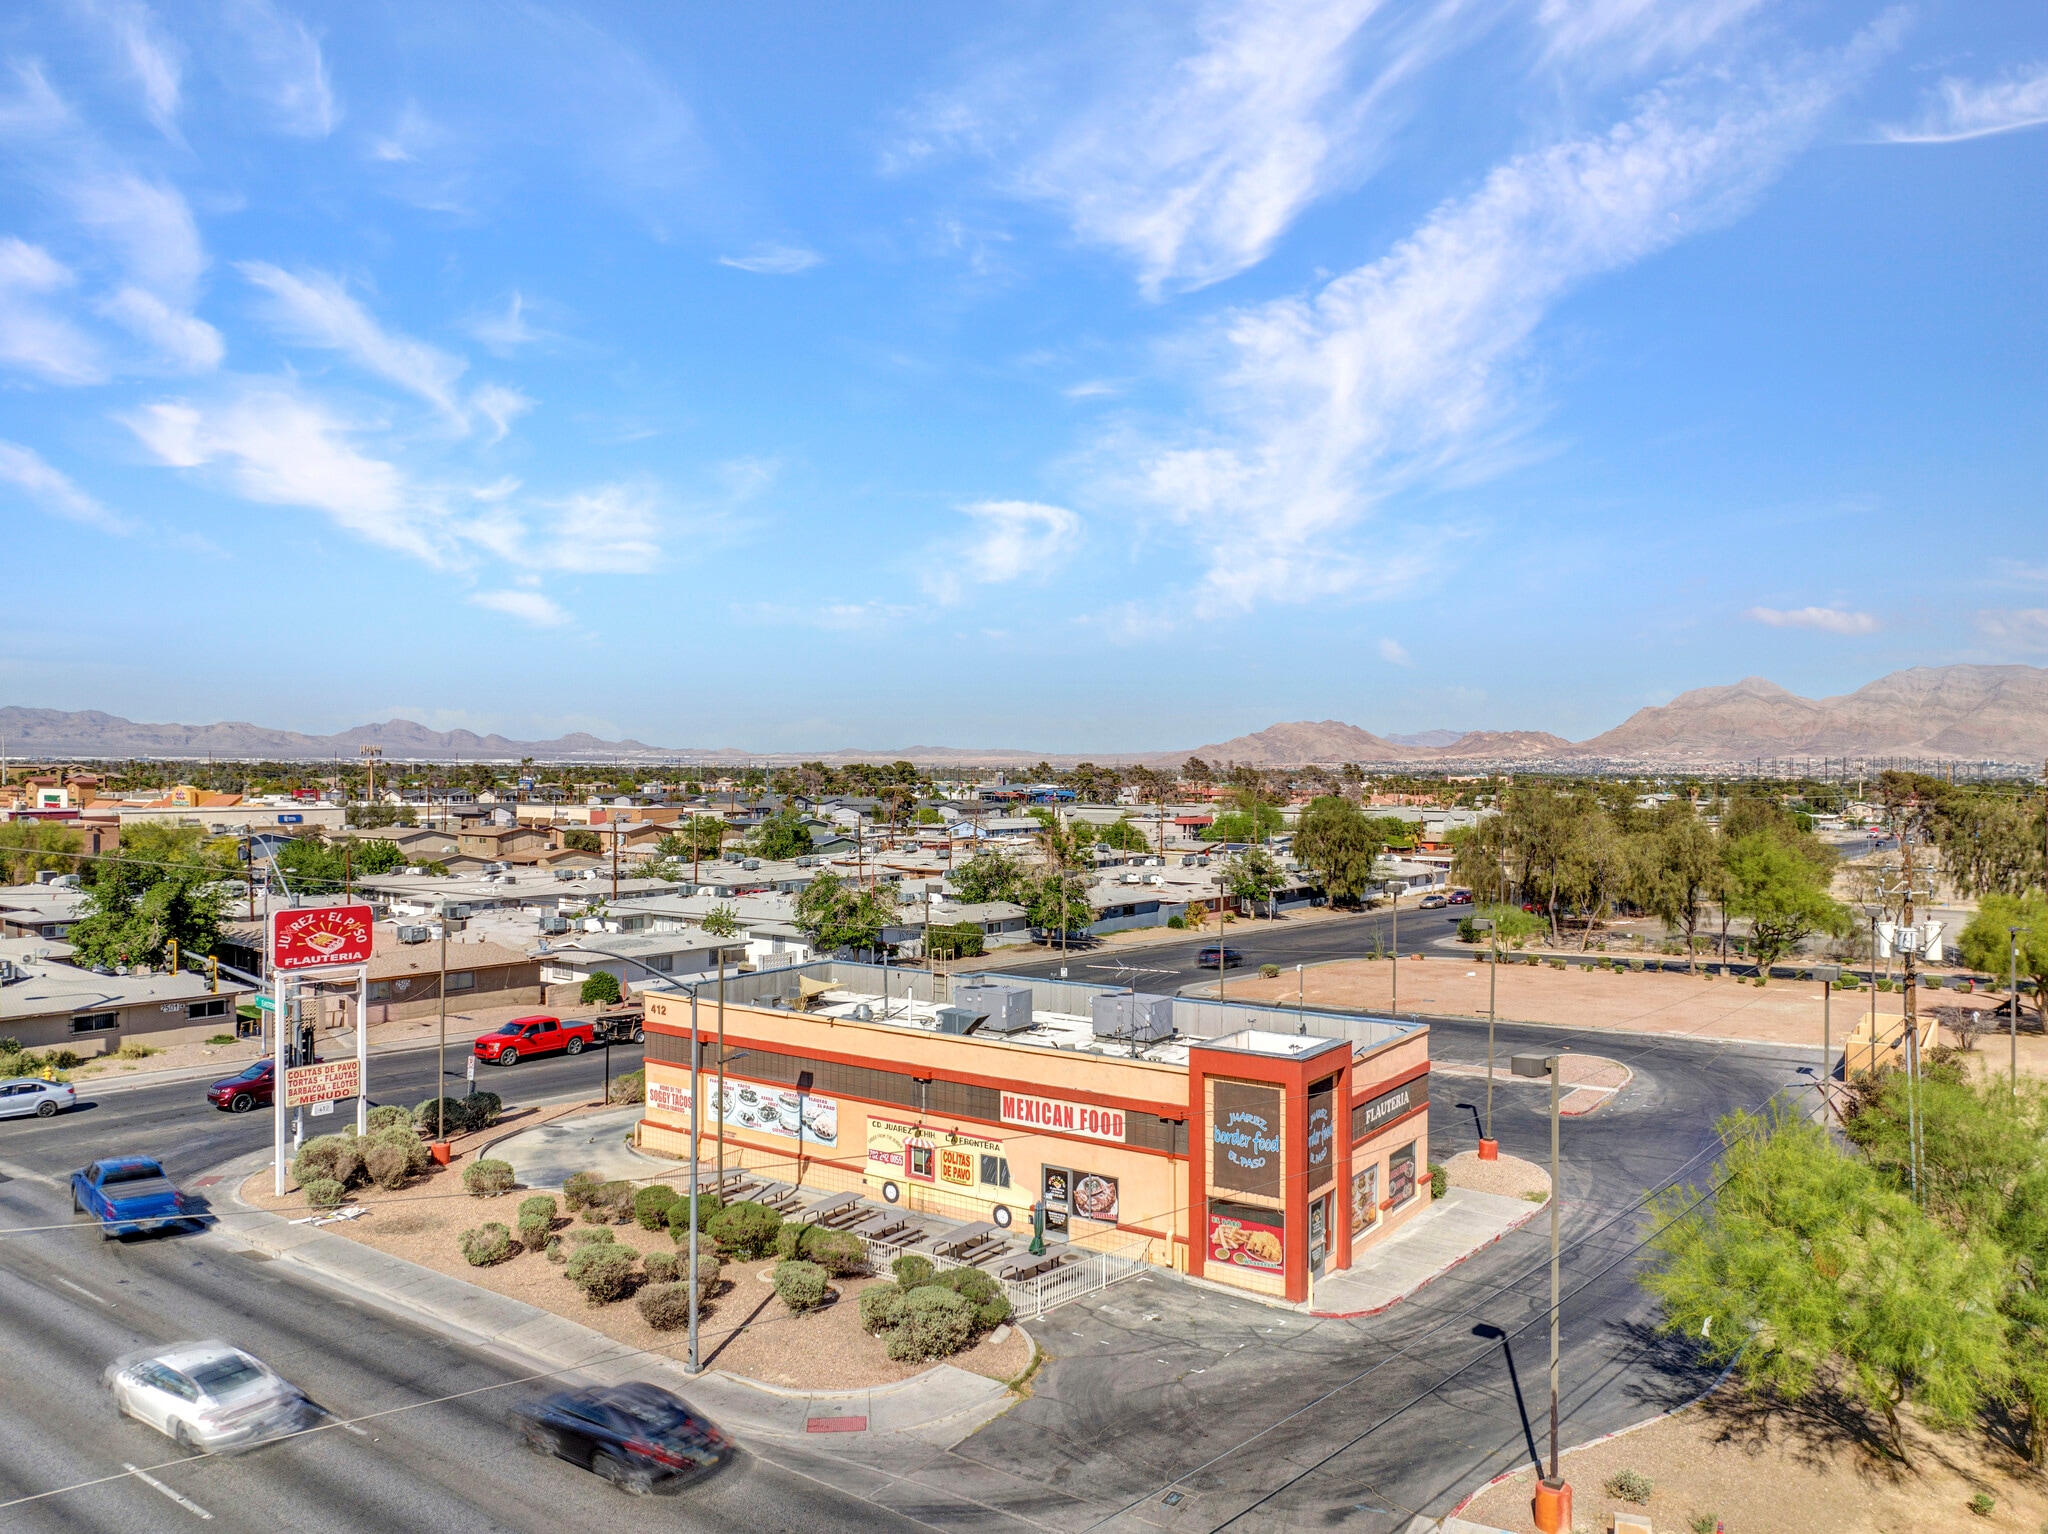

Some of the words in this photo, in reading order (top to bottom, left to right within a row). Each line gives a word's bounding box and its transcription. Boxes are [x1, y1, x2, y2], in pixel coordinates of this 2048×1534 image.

[328, 912, 342, 923] EL
[285, 952, 362, 966] FLAUTERIA
[651, 1004, 667, 1015] 412
[288, 1068, 322, 1080] COLITAS
[325, 1065, 335, 1074] DE
[338, 1062, 357, 1072] PAVO
[288, 1077, 318, 1087] TORTAS
[325, 1071, 357, 1082] FLAUTAS
[288, 1084, 326, 1097] BARBACOA
[332, 1079, 358, 1090] ELOTES
[300, 1088, 350, 1104] MENUDO
[650, 1088, 671, 1104] SOGGY
[671, 1092, 692, 1109] TACOS
[1365, 1090, 1410, 1125] FLAUTERIA
[1002, 1096, 1074, 1129] MEXICAN
[1080, 1108, 1123, 1137] FOOD
[1227, 1111, 1267, 1132] JUAREZ
[884, 1122, 912, 1135] JUAREZ
[959, 1138, 1000, 1151] FRONTERA
[1214, 1125, 1251, 1148] border
[1252, 1131, 1279, 1155] food
[1308, 1128, 1320, 1149] rder
[943, 1151, 970, 1168] COLITAS
[1228, 1150, 1240, 1164] EL
[1240, 1156, 1266, 1169] PASO
[943, 1165, 951, 1177] DE
[953, 1167, 970, 1181] PAVO
[1211, 1216, 1220, 1224] EL
[1221, 1218, 1242, 1228] PASO
